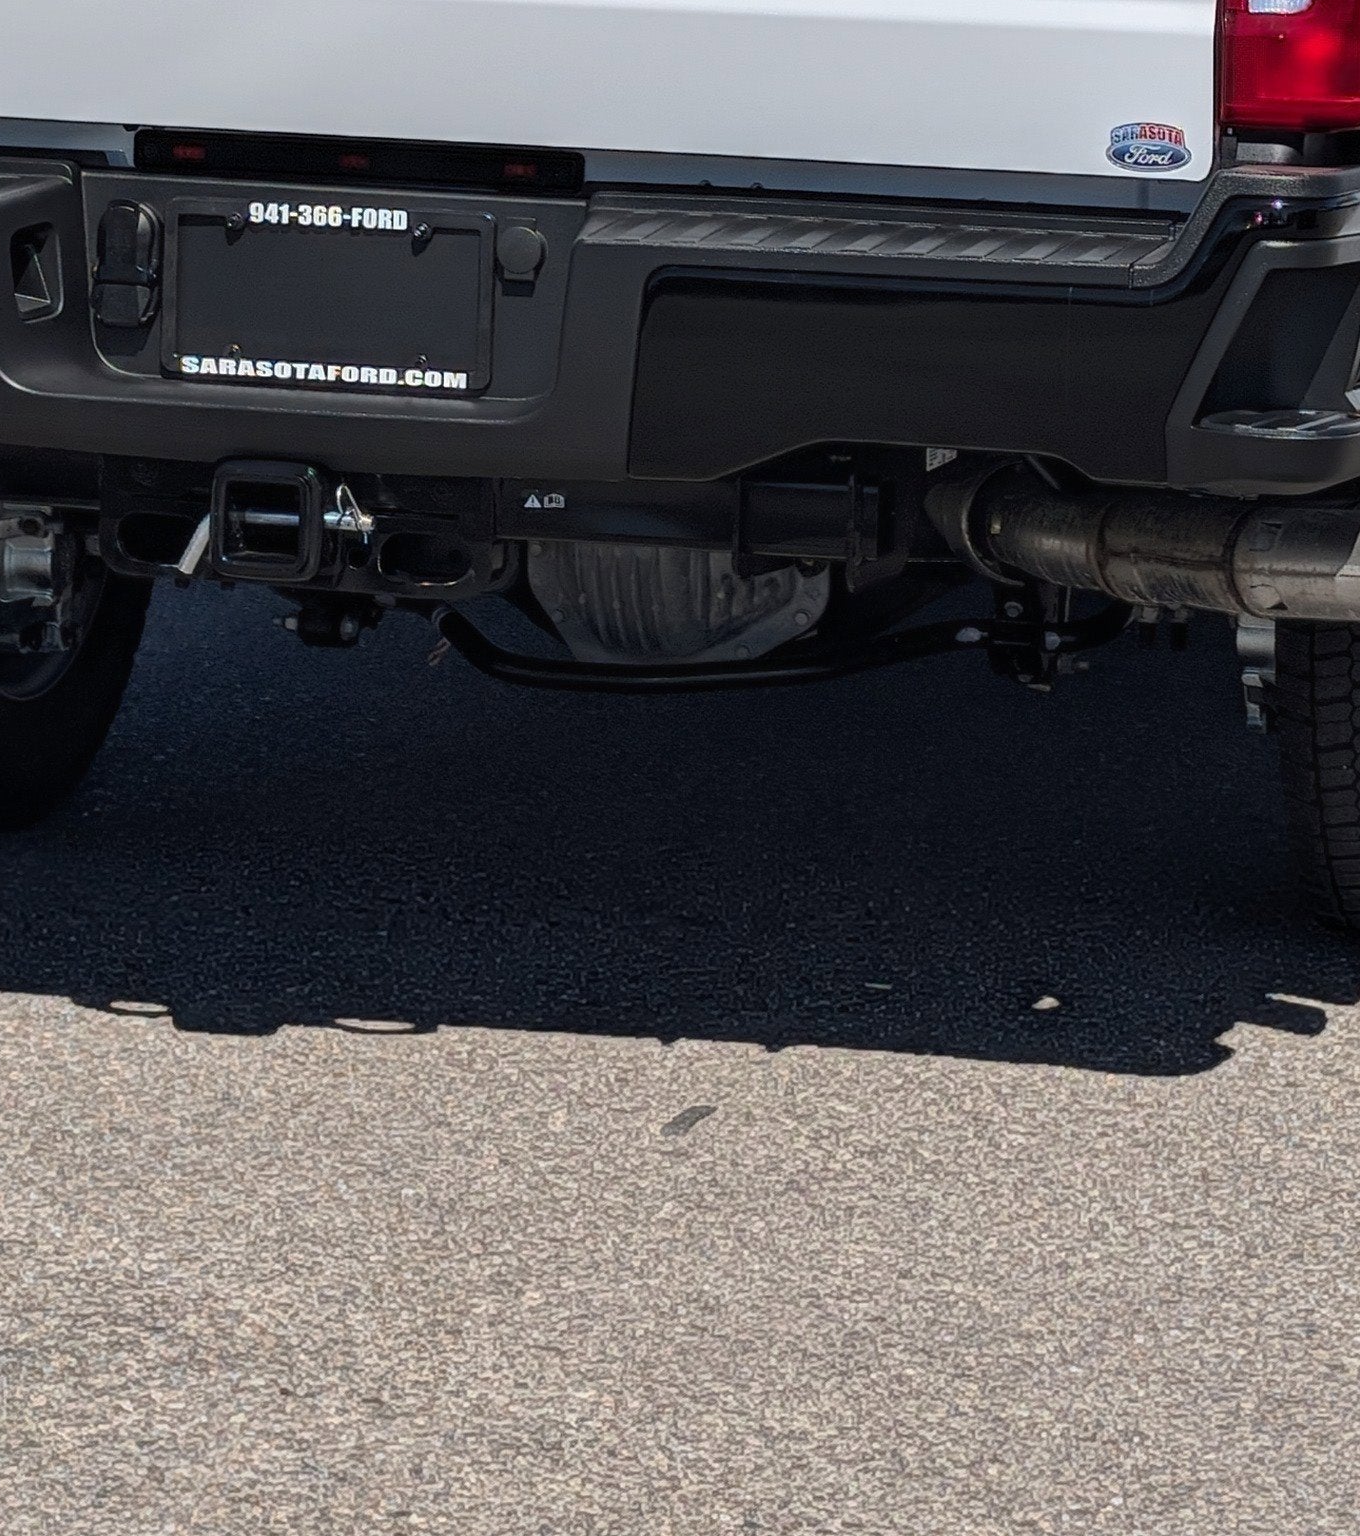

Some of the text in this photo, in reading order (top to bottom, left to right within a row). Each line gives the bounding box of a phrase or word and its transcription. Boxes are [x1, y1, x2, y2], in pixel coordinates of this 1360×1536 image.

[1113, 125, 1183, 145] SARASOTA
[1124, 144, 1173, 165] Ford
[248, 201, 409, 232] 941-366-FORD
[180, 355, 468, 390] SARASOTAFORD.COM
